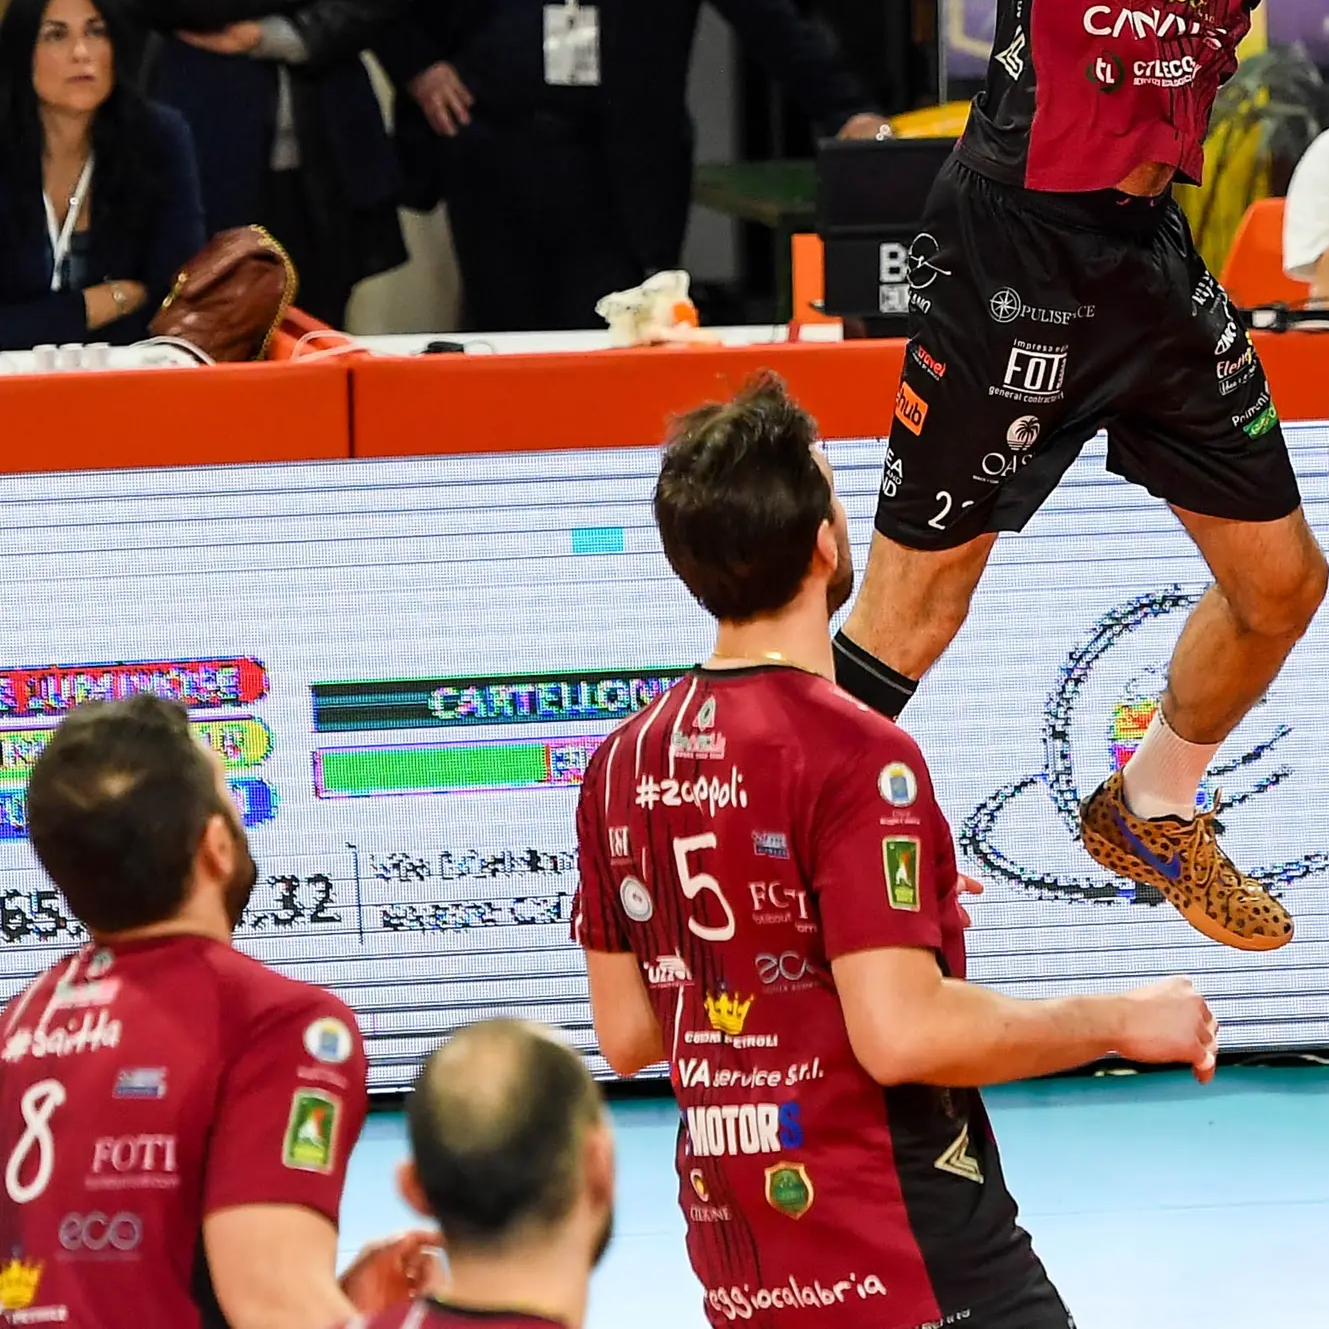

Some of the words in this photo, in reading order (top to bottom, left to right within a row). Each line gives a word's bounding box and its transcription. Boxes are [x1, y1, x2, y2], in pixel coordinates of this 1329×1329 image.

[886, 448, 904, 477] EA
[673, 831, 736, 942] 5
[675, 1058, 711, 1088] VA
[713, 1065, 782, 1089] service
[5, 1078, 67, 1203] 8
[92, 1133, 177, 1173] FOTI
[685, 1101, 803, 1158] MOTORS
[705, 1272, 886, 1321] eggiocalabria
